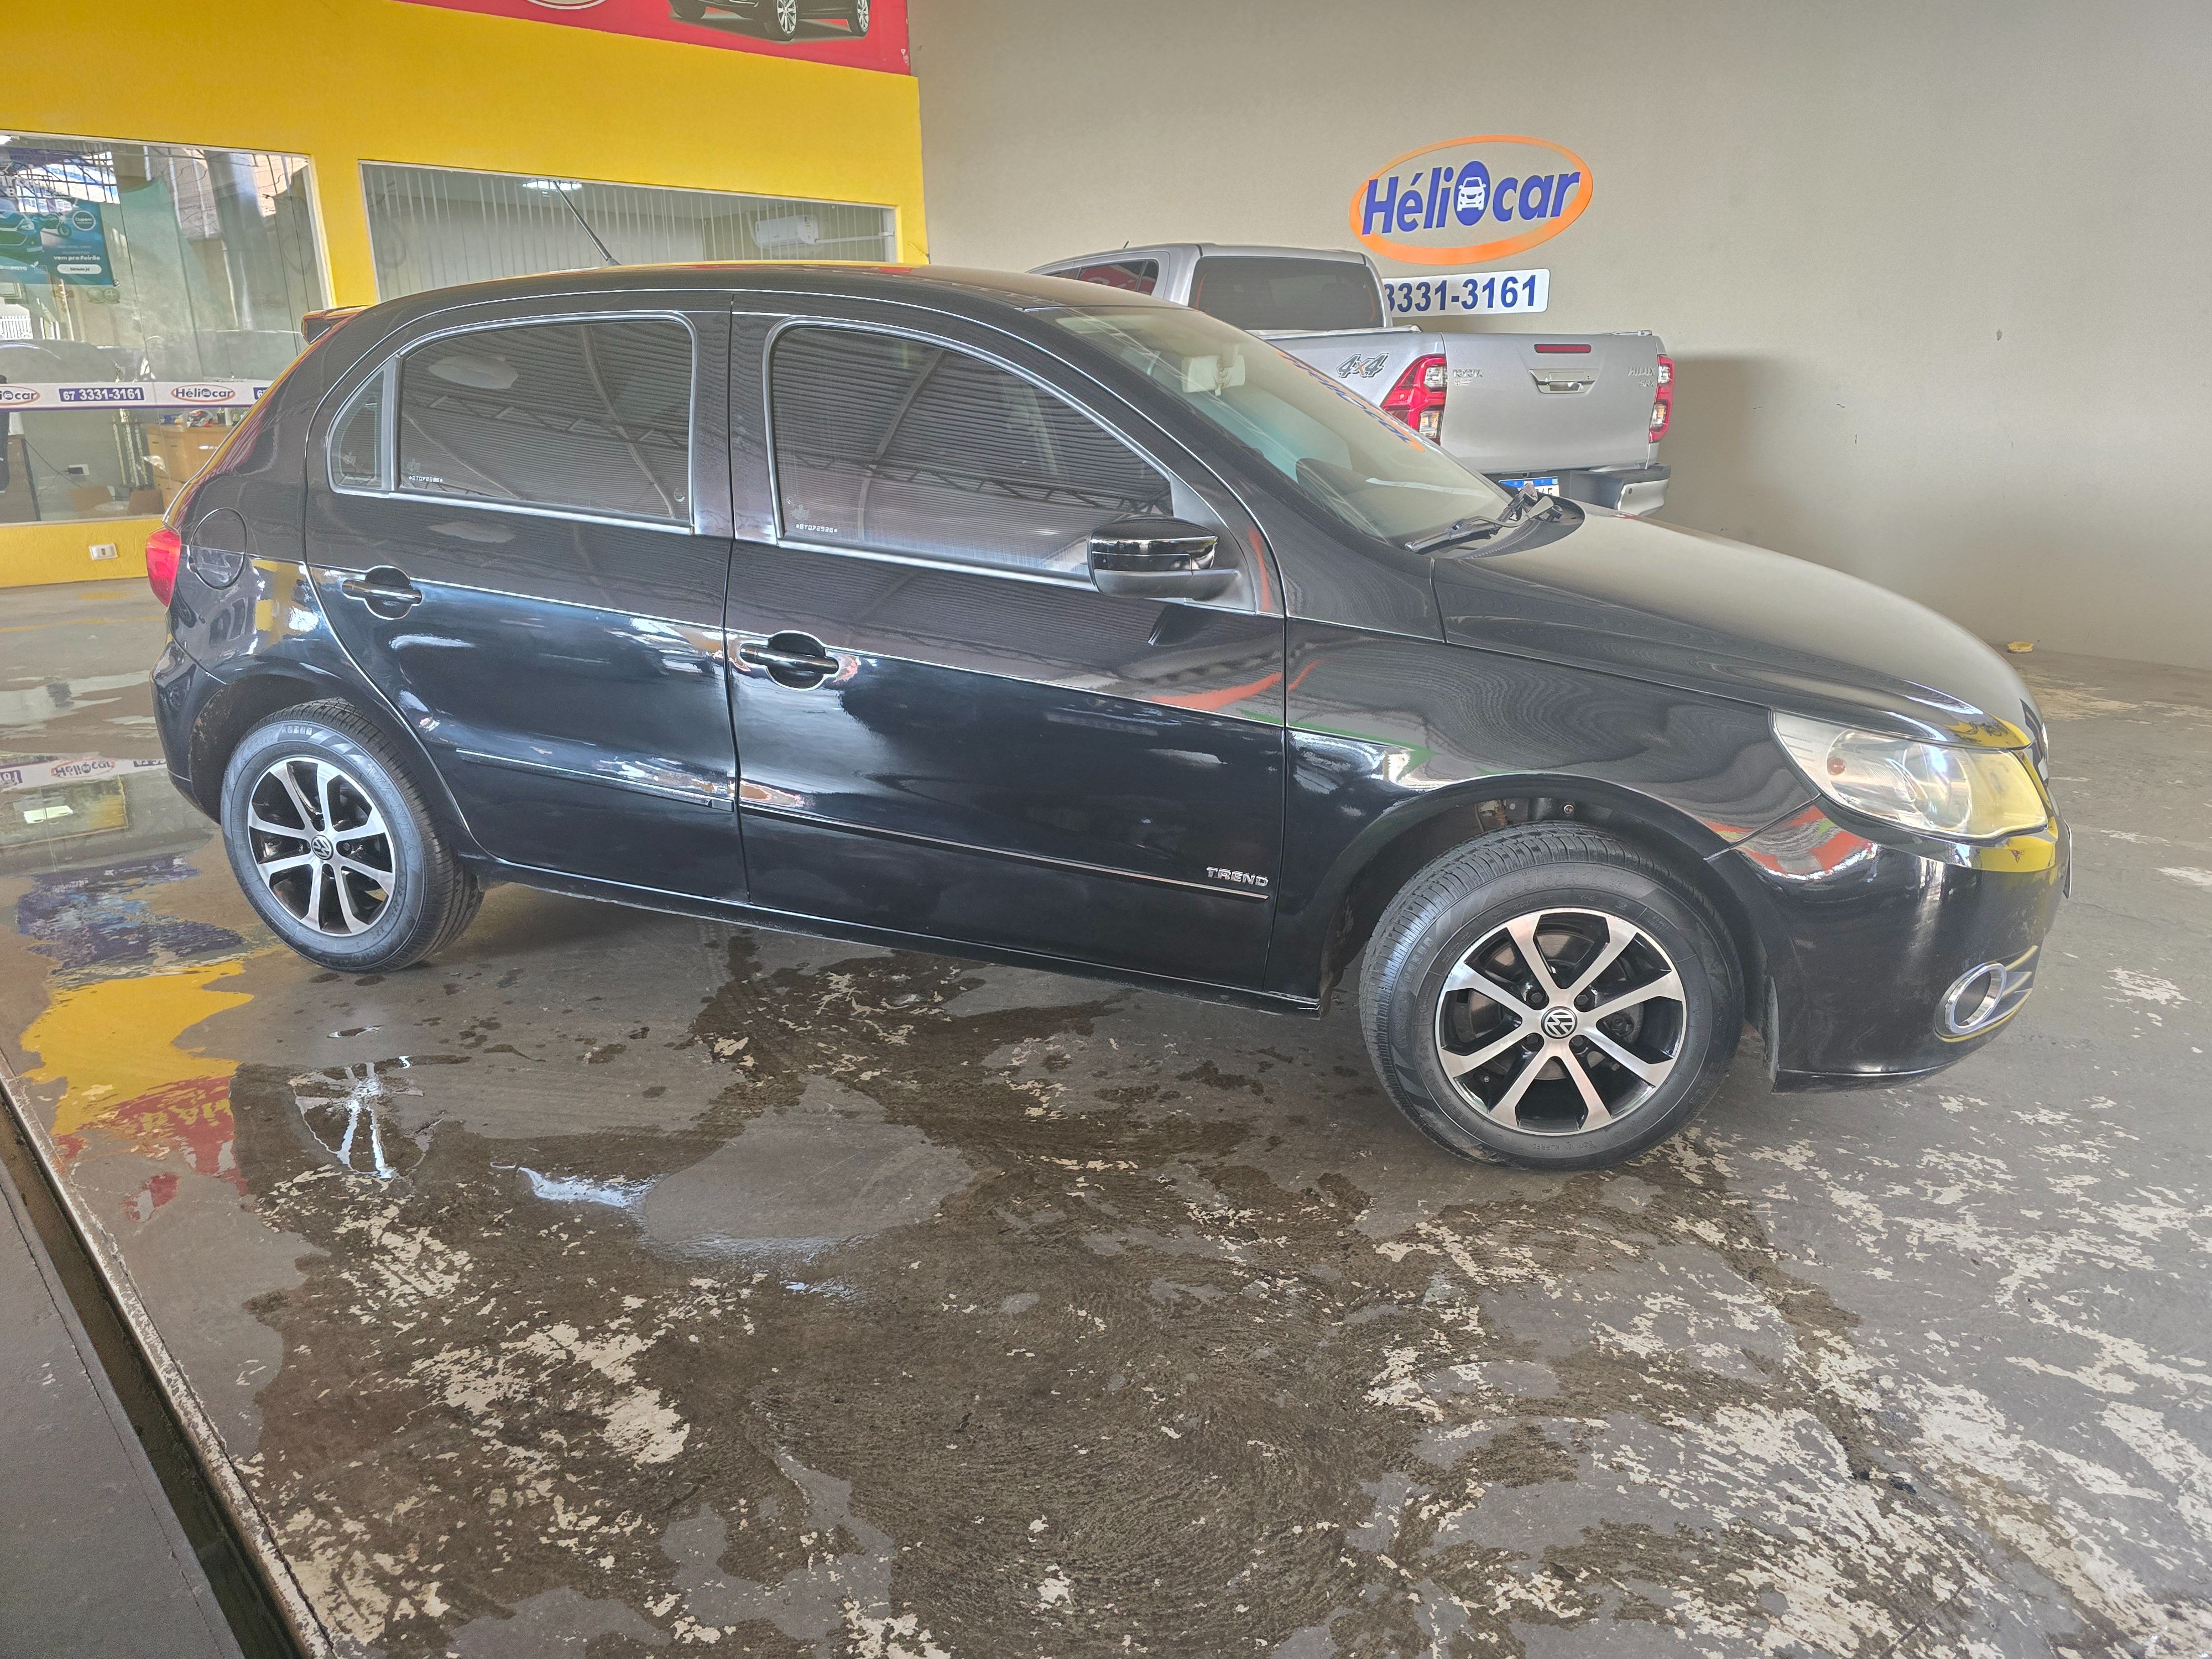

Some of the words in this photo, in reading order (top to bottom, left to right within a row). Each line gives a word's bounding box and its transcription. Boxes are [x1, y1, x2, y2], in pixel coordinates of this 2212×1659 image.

[1453, 369, 1483, 377] TOYOTA
[1627, 367, 1655, 376] HILUX
[63, 392, 75, 400] 67
[79, 389, 141, 400] 3331-3161
[367, 763, 419, 856] WANDA
[1206, 867, 1269, 887] TREND
